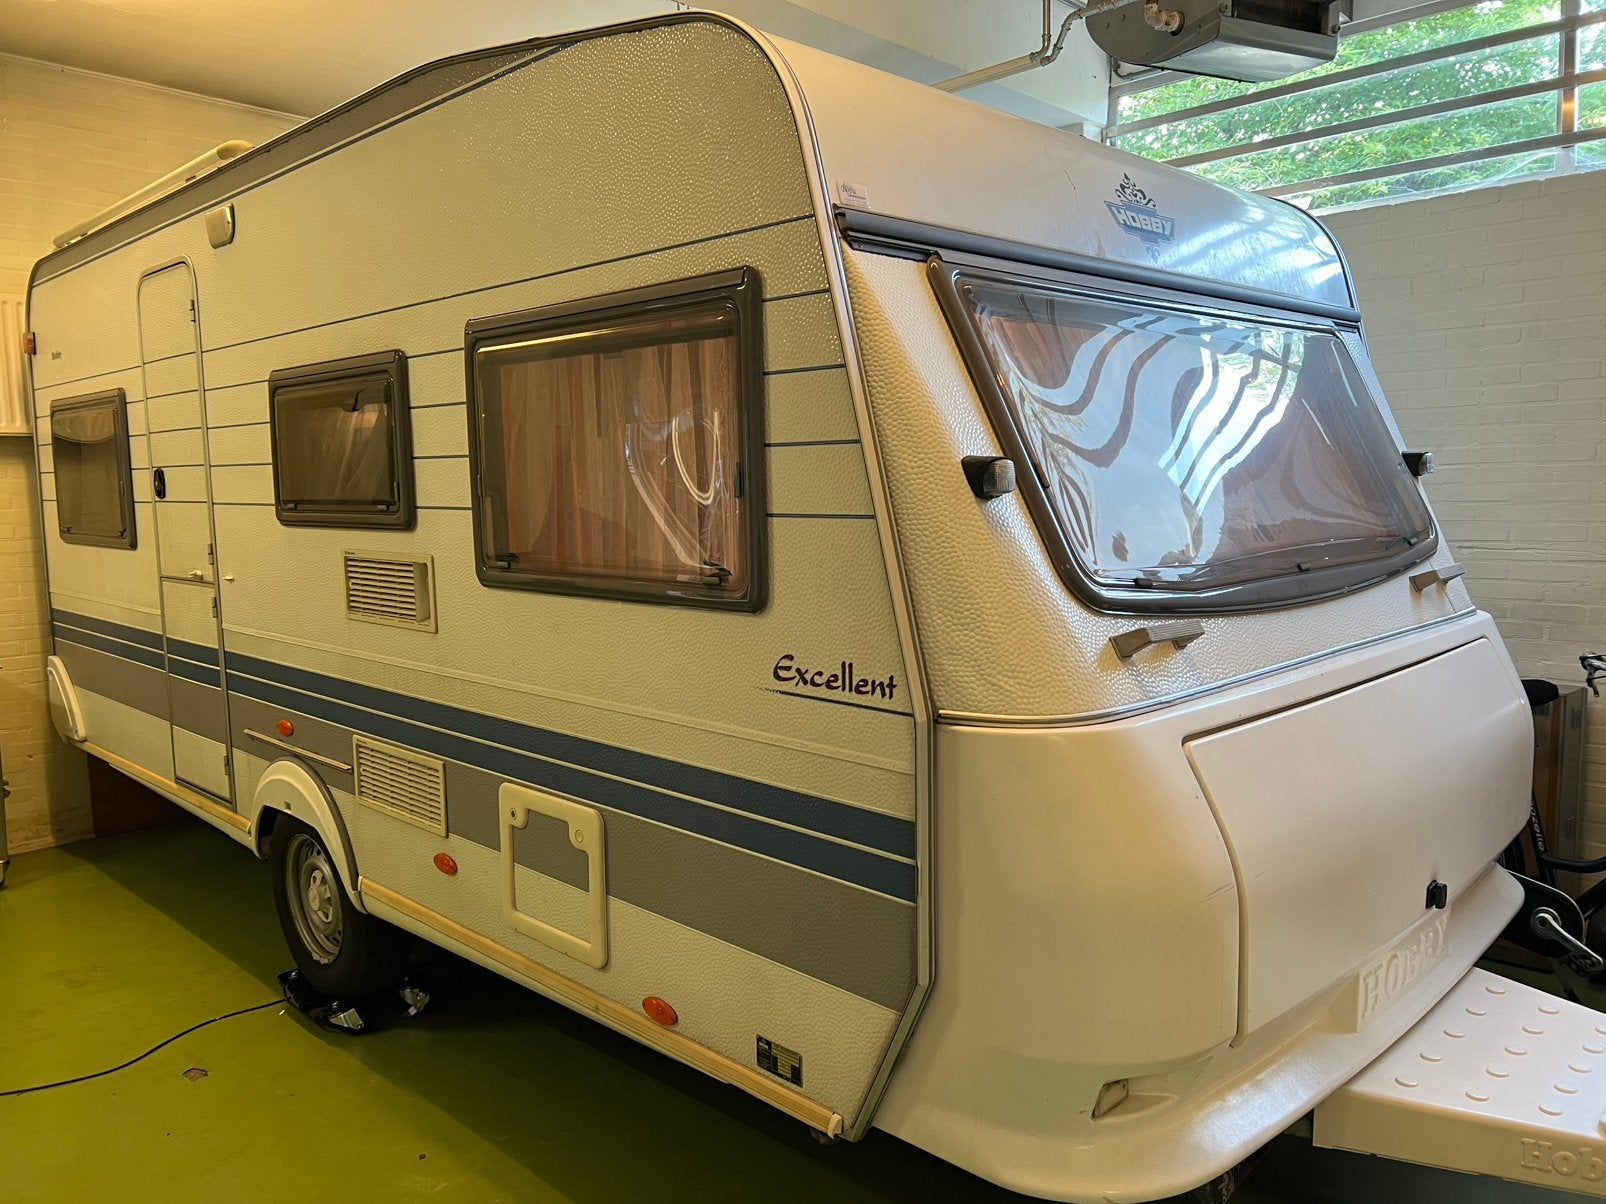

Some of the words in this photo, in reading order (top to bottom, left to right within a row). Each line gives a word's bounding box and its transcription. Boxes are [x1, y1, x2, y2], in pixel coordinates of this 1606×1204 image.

[1110, 205, 1174, 237] HOBBY
[772, 653, 898, 700] Excellent
[1361, 914, 1449, 1020] HOBBY
